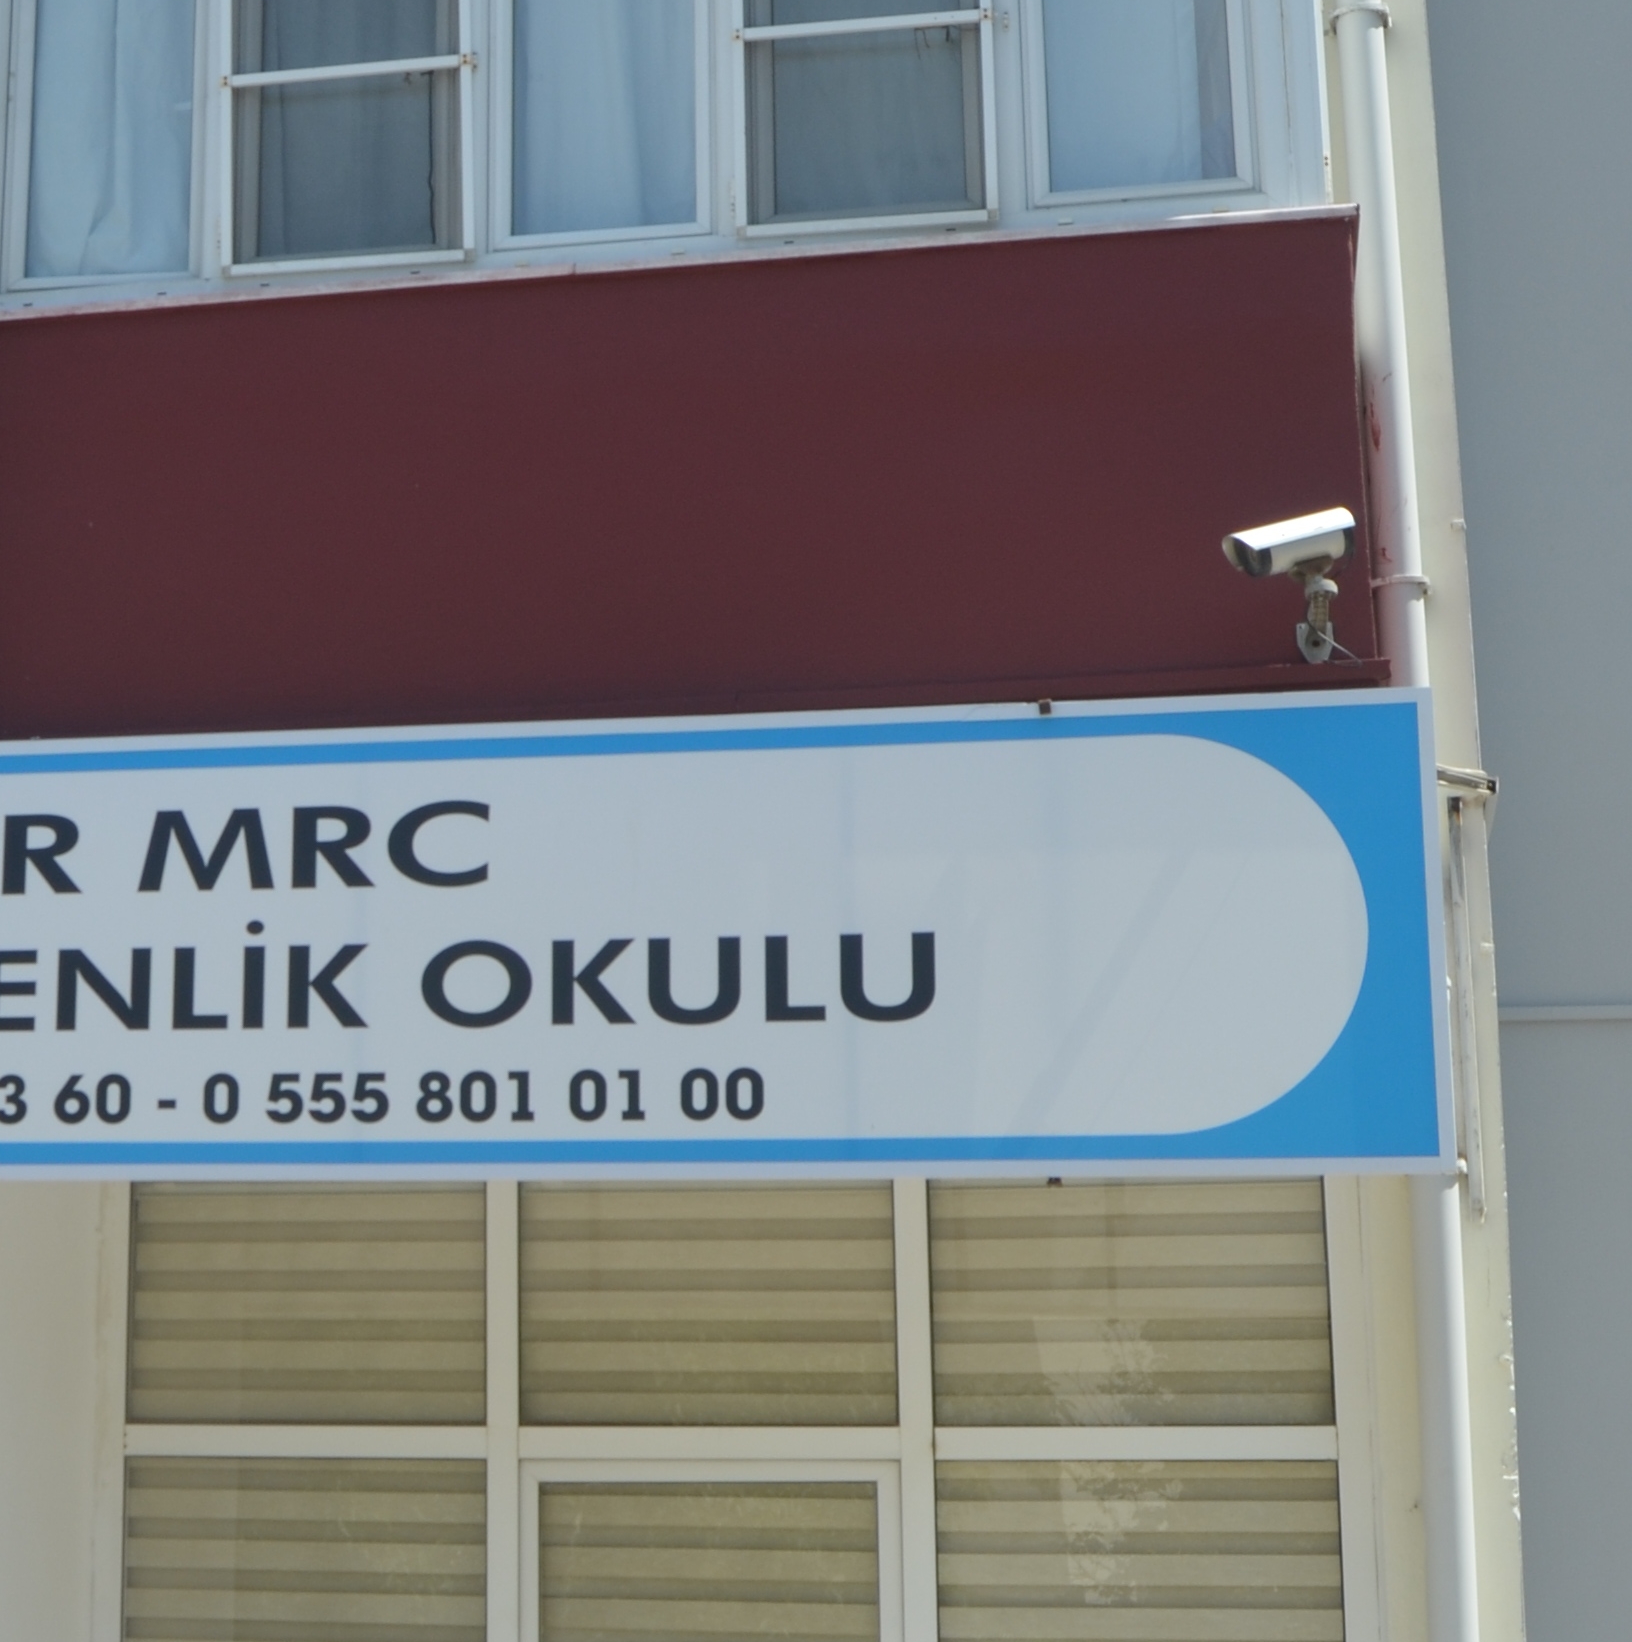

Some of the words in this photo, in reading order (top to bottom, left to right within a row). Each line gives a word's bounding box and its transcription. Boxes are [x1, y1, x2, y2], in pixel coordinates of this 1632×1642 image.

[138, 800, 490, 892] MRC
[420, 932, 937, 1030] OKULU
[54, 1073, 132, 1125] 60
[158, 1099, 177, 1110] -
[203, 1073, 239, 1124] 0
[266, 1072, 389, 1124] 555
[416, 1071, 535, 1123] 801
[569, 1069, 645, 1122] 01
[680, 1067, 765, 1121] 00
